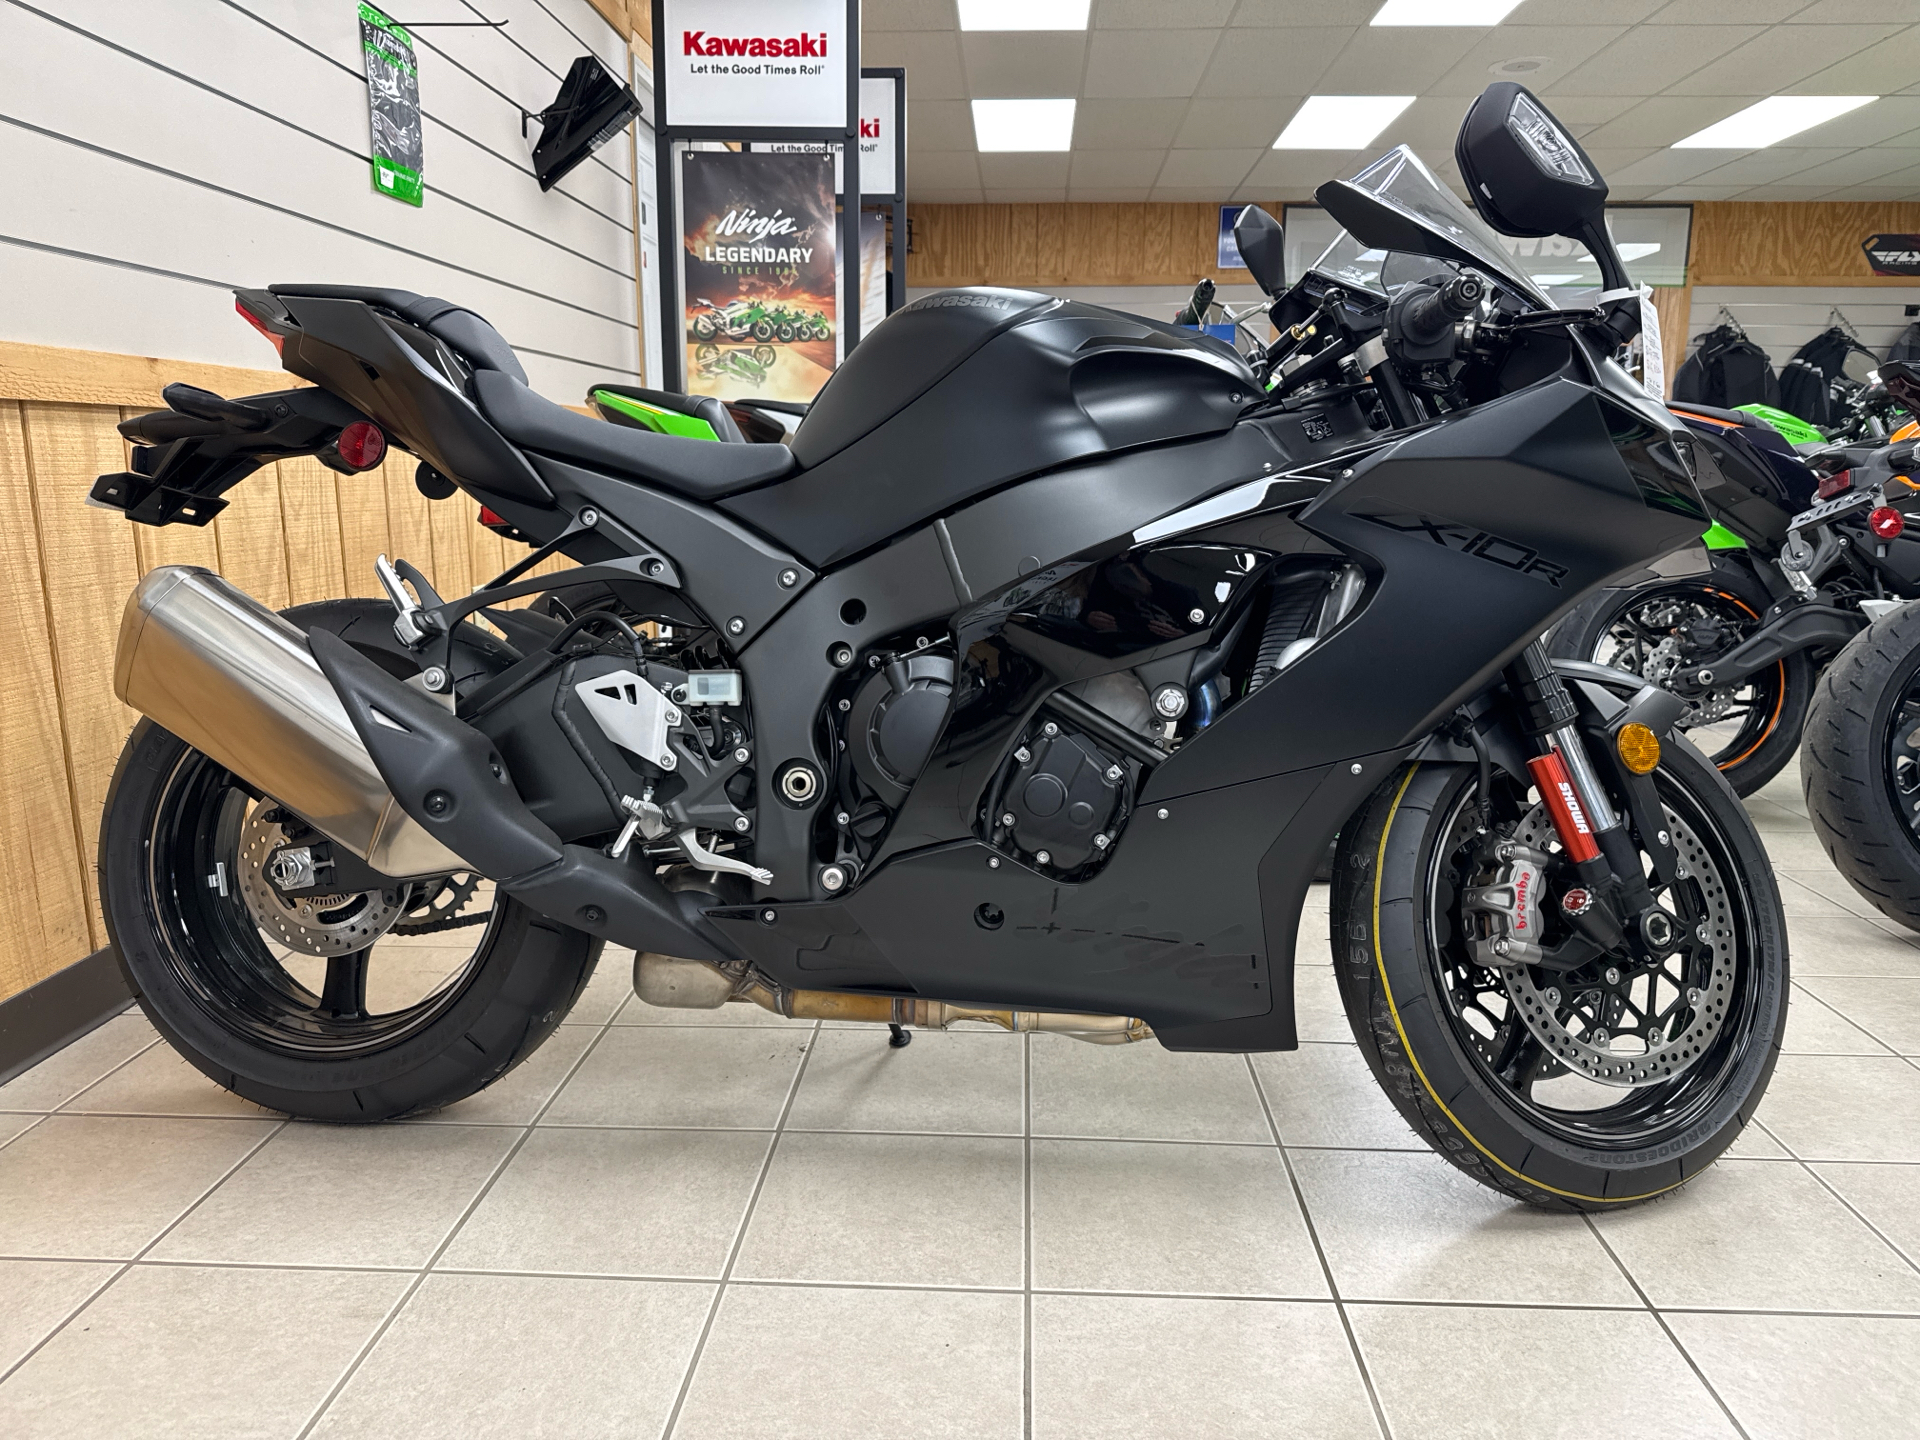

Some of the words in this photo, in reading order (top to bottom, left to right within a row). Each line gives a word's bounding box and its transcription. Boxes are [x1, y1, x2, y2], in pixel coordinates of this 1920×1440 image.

[683, 31, 828, 58] Kawasaki
[690, 64, 708, 74] Let
[711, 64, 729, 74] the
[731, 64, 761, 75] Good
[763, 64, 797, 75] Times
[799, 64, 822, 75] Roll
[770, 144, 785, 152] Let
[787, 144, 802, 152] the
[714, 208, 798, 244] Ninja
[704, 246, 814, 264] LEGENDARY
[721, 266, 760, 275] SINCE
[1557, 782, 1590, 834] SHOWA
[1515, 871, 1532, 930] brembo
[1586, 1119, 1713, 1166] BRIDGESTONE
